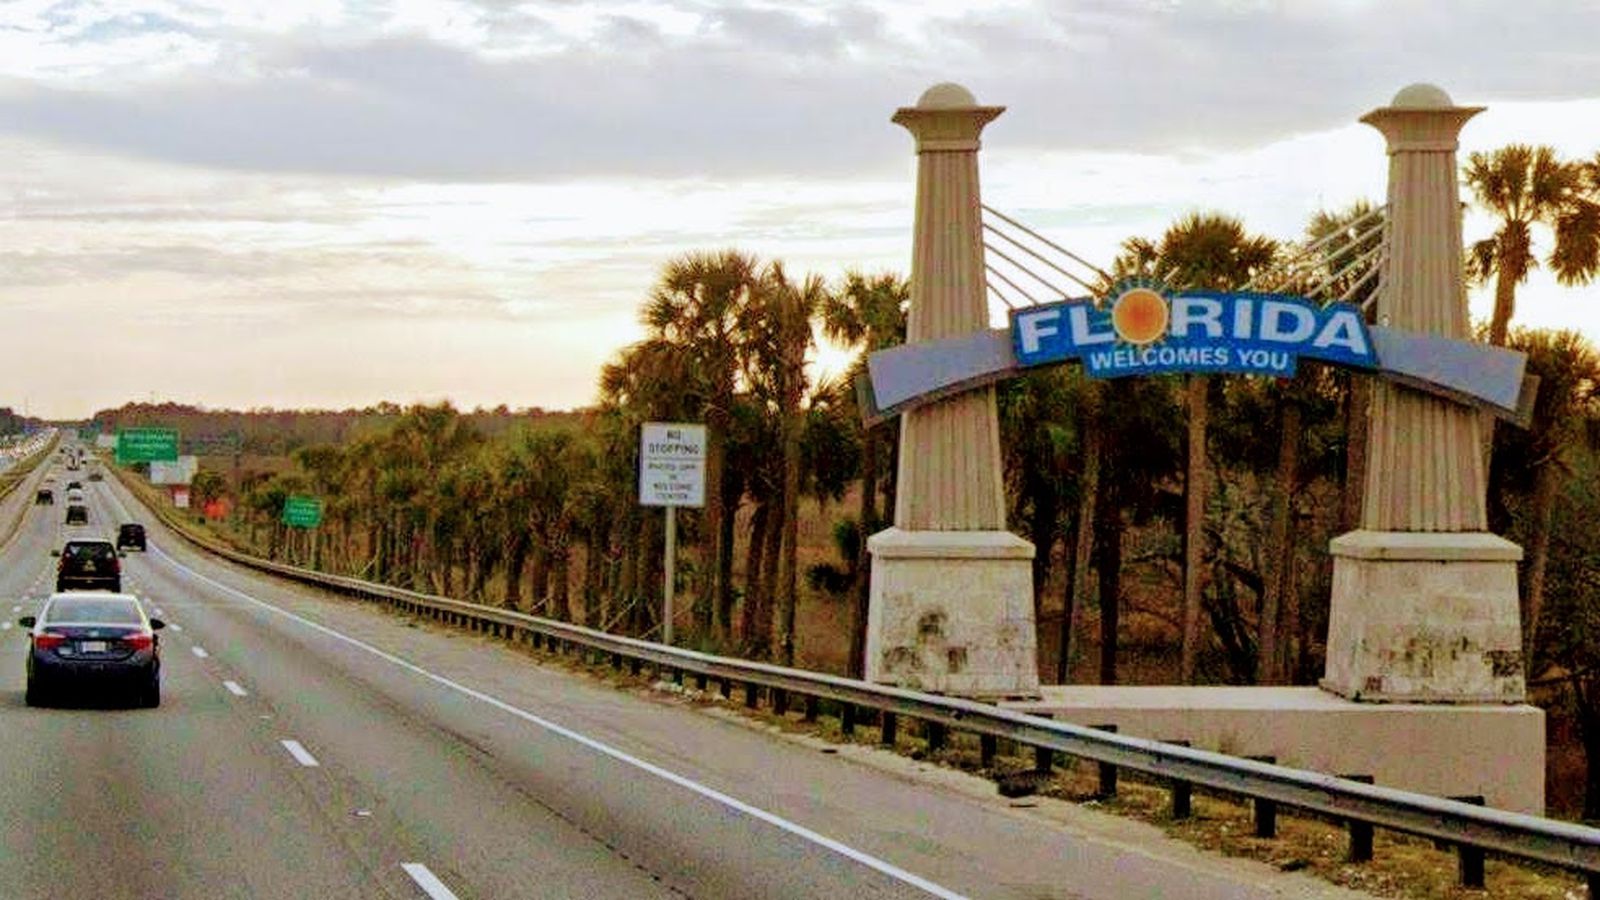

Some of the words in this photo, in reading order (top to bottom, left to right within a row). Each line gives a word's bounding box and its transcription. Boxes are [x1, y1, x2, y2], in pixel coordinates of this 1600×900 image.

[1017, 286, 1368, 355] FLORIDA
[1090, 347, 1229, 369] WELCOMES
[1237, 348, 1288, 369] YOU
